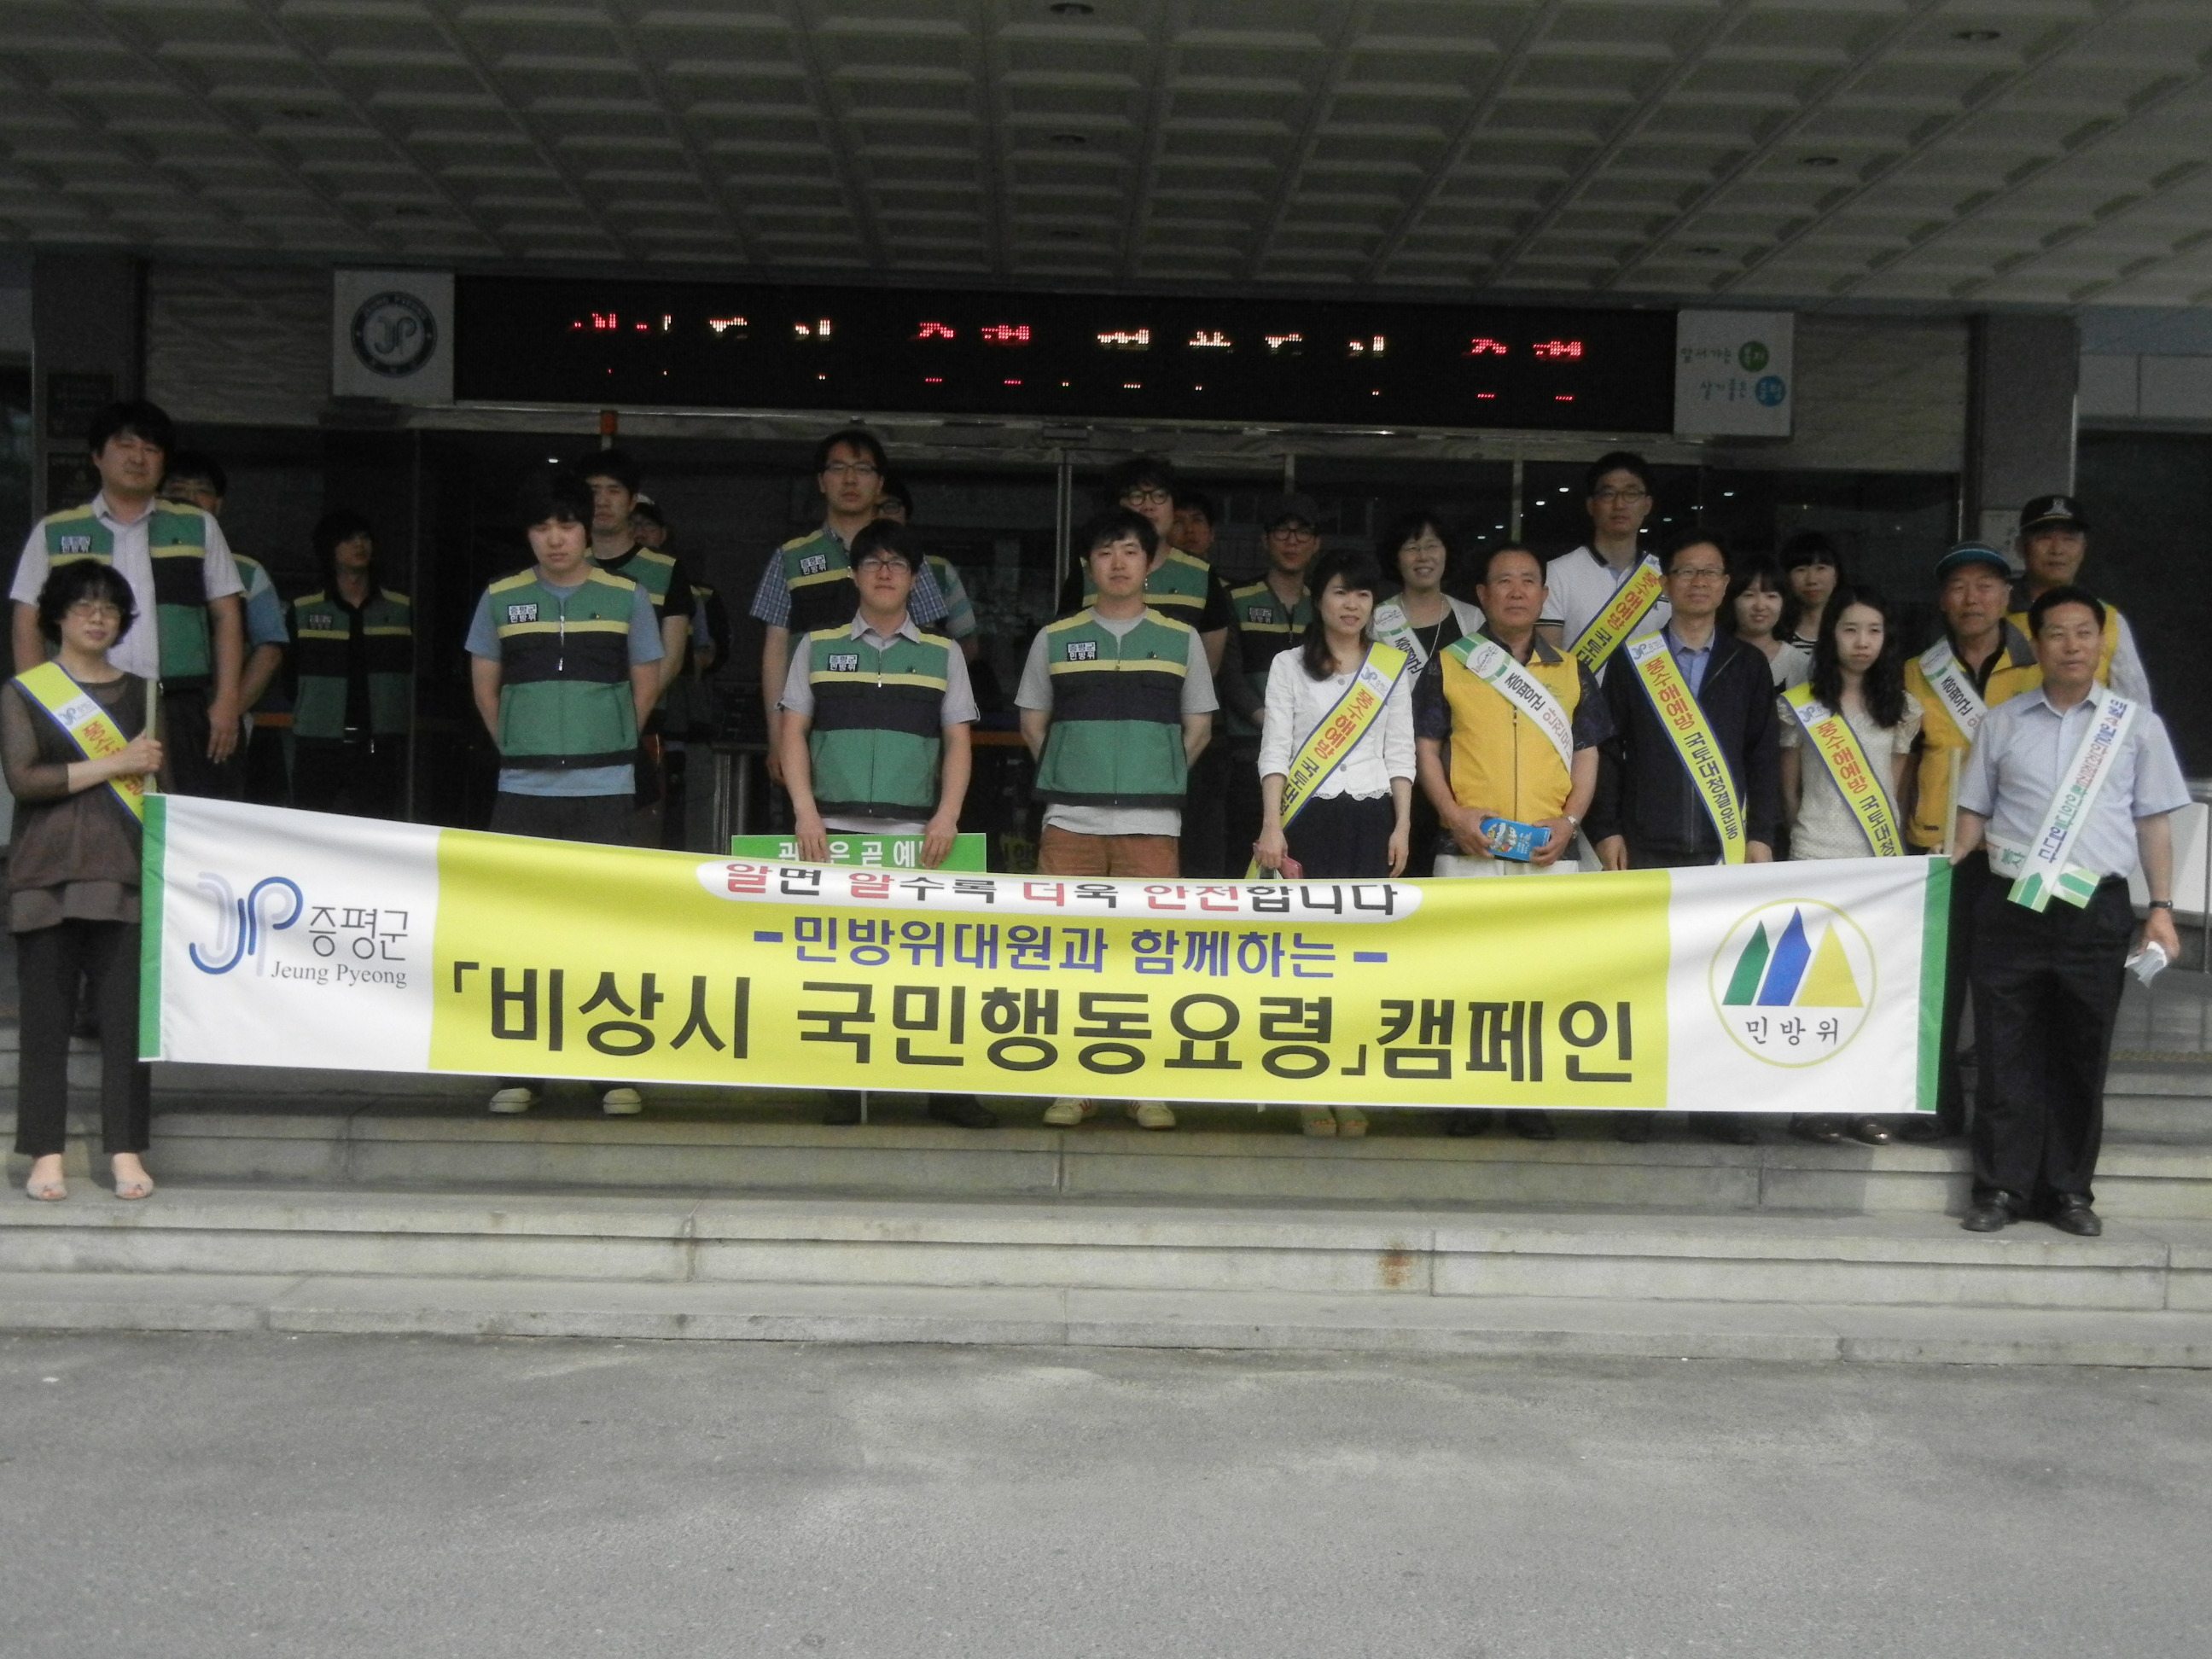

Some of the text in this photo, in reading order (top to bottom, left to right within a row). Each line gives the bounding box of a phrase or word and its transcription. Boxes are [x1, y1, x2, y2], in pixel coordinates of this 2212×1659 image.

[800, 554, 826, 569] 증평군
[802, 563, 827, 576] 민방위
[509, 603, 537, 615] 증평군
[1606, 571, 1659, 631] 풍수해예방
[509, 614, 537, 623] 민방위
[830, 654, 858, 664] 증평군
[1068, 642, 1096, 653] 증평군
[1068, 651, 1096, 661] 민방위
[830, 663, 858, 672] 민방위
[1504, 672, 1545, 712] 증평군
[1644, 657, 1695, 731] 풍수해예방
[1940, 675, 1973, 717] 증평군
[1313, 688, 1375, 760] 풍수해예방
[1816, 719, 1868, 795] 풍수해예방
[860, 841, 884, 868] 곧
[893, 840, 925, 868] 예
[725, 863, 1399, 916] 알면 알수록 더욱 안전합니다
[308, 906, 409, 961] 증평군
[271, 961, 408, 988] Jeung Pyeong
[1744, 1016, 1838, 1046] 민방위
